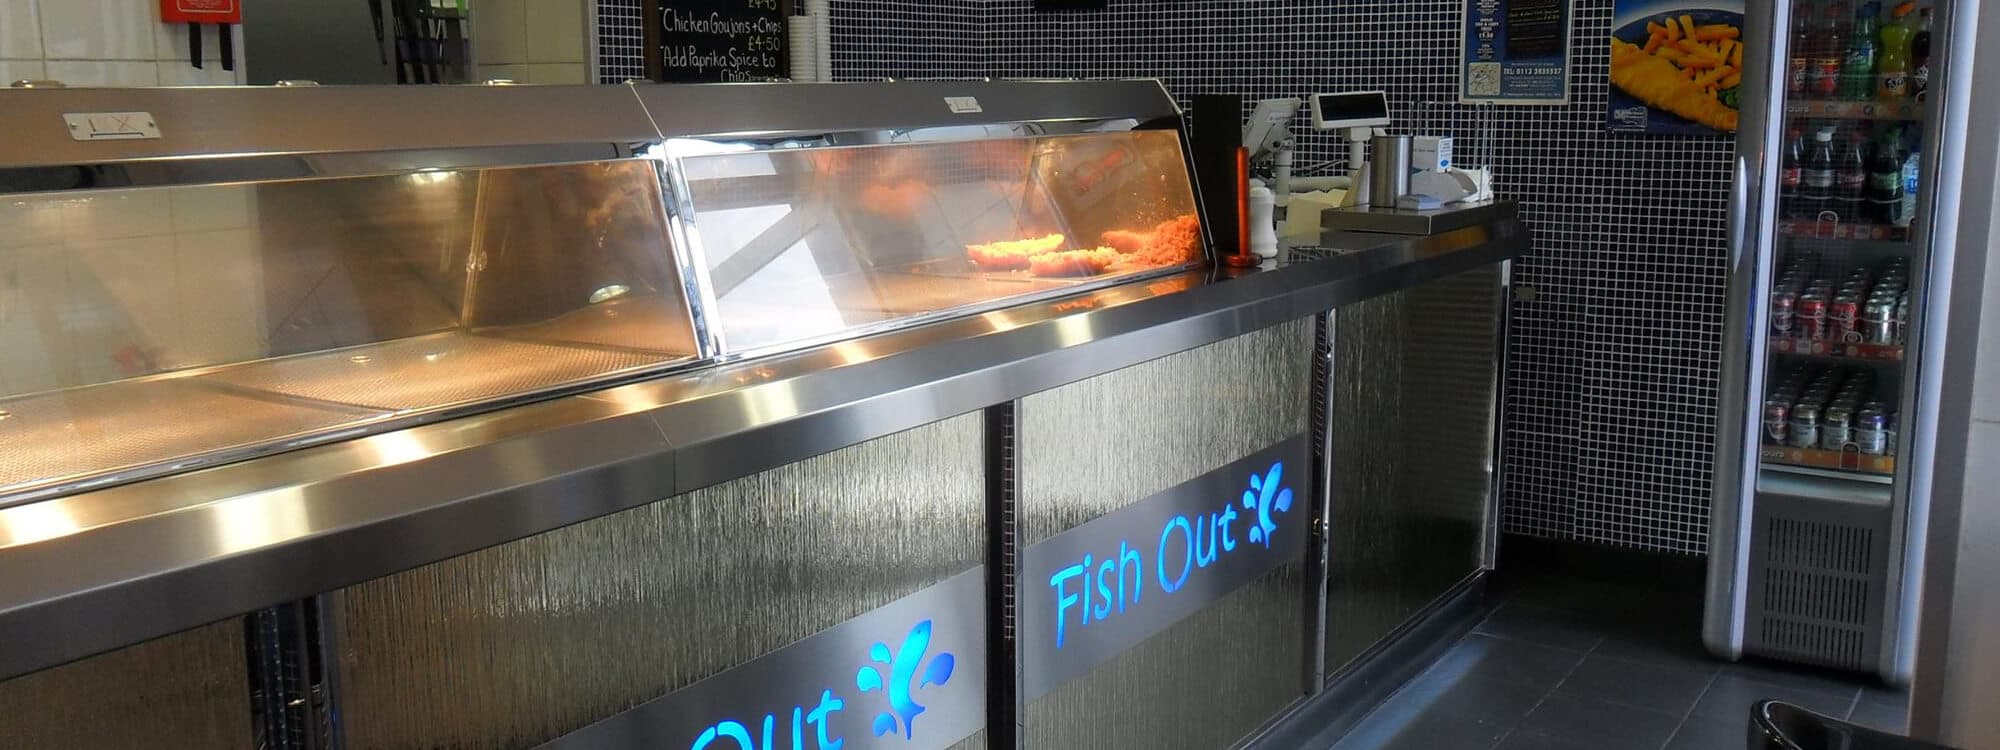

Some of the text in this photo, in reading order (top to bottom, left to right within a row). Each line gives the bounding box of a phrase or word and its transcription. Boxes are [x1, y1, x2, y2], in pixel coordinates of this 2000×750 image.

[663, 8, 709, 32] Chicken
[710, 12, 750, 38] Goujons
[663, 45, 776, 73] Add Paprika Spice to
[1050, 503, 1237, 649] Fish Out
